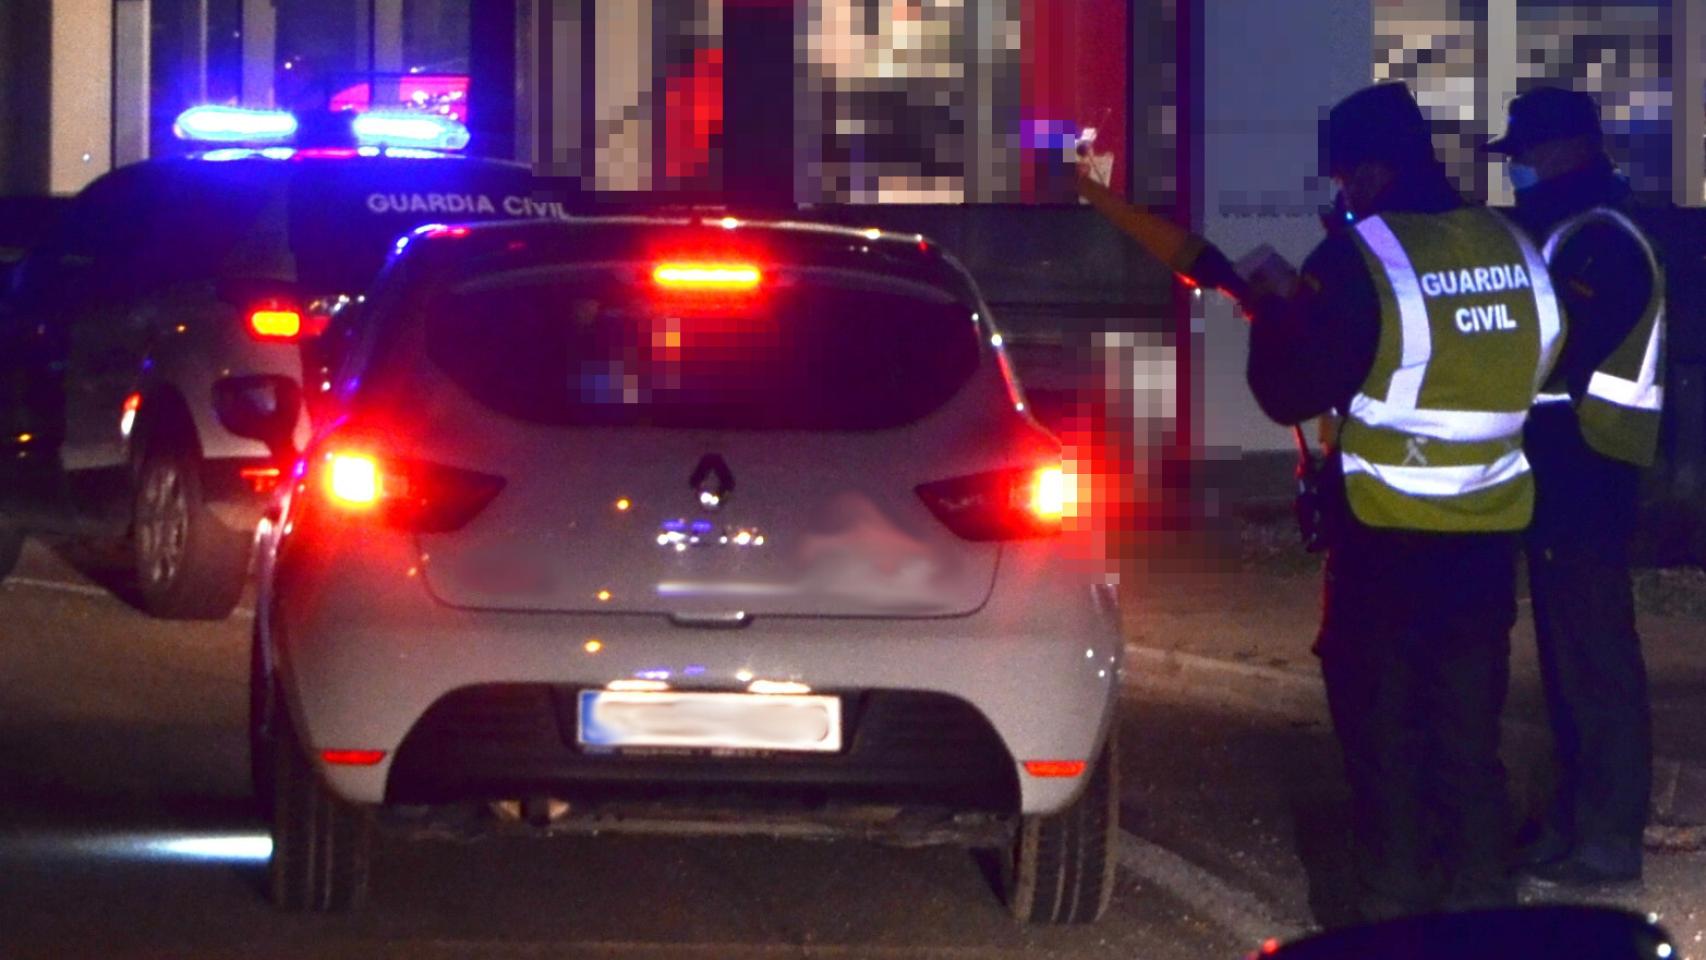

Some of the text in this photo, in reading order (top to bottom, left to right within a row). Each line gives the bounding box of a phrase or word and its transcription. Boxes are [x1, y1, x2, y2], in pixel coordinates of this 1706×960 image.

[367, 193, 570, 219] GUARDIA CIVIL
[1421, 264, 1530, 296] GUARDIA
[1455, 304, 1517, 332] CIVIL
